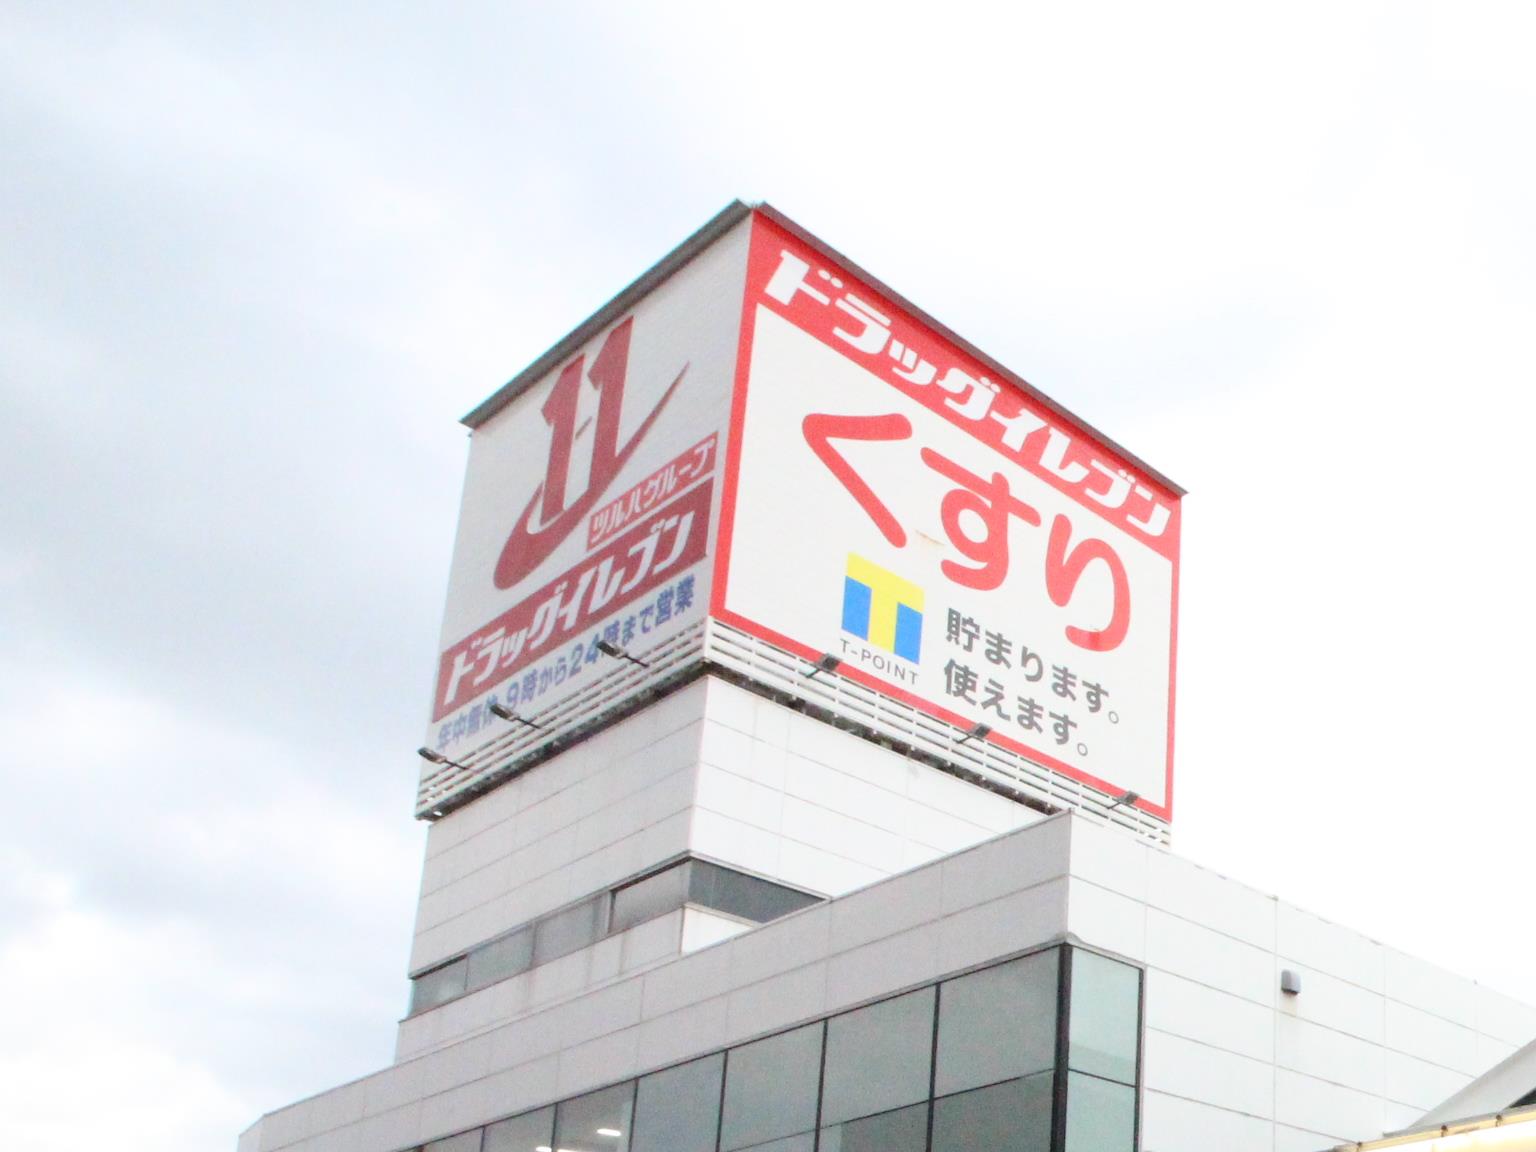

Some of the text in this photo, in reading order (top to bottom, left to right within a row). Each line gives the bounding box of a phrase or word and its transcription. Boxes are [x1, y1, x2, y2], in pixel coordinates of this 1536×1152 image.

[764, 249, 1171, 537] ドラッグイレブン
[590, 437, 717, 544] ツルハグループ
[801, 412, 1131, 651] くすり
[444, 511, 696, 706] ドラッグイレブン
[839, 638, 920, 685] T-POINT
[946, 607, 1120, 725] 貯まります。
[944, 658, 1088, 757] 使えます。
